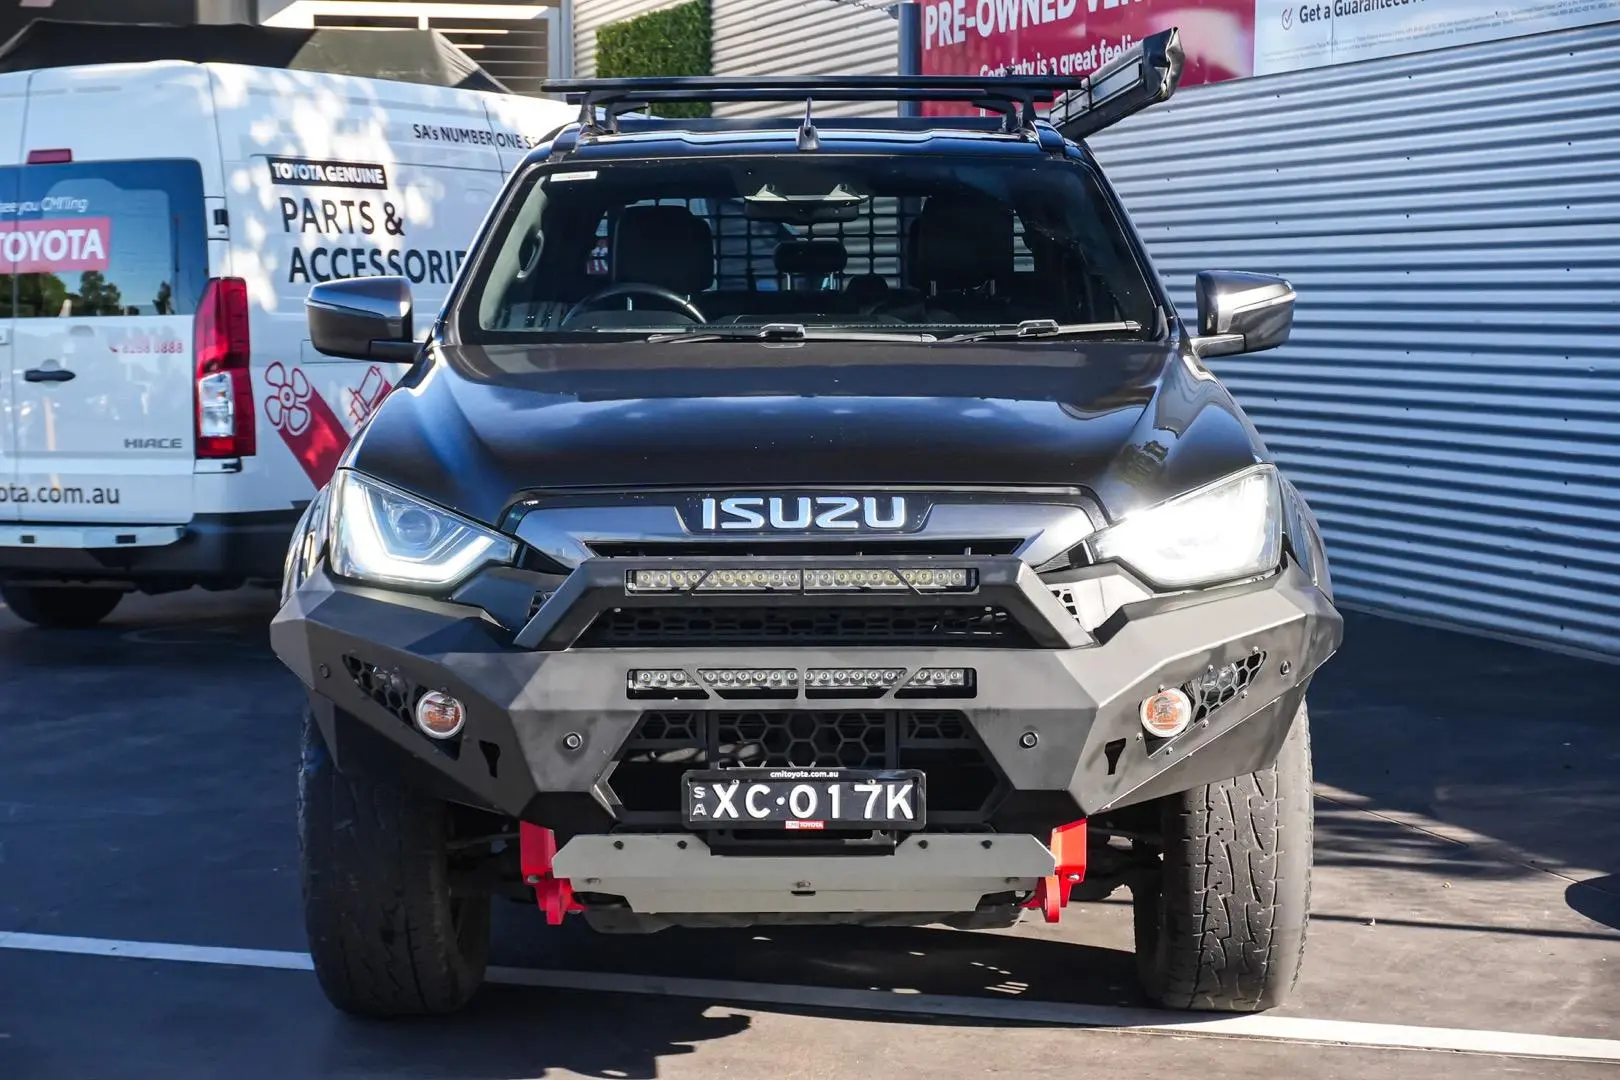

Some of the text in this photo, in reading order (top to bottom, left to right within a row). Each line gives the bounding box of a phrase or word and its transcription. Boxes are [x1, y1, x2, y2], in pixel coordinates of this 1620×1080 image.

[925, 0, 1076, 49] PRE-OWNED
[1300, 4, 1321, 24] Get
[1323, 9, 1331, 19] a
[1037, 51, 1048, 76] is
[1060, 44, 1098, 75] great
[413, 124, 439, 141] SA's
[440, 127, 495, 146] NUMBER
[496, 132, 523, 149] ONE
[272, 162, 385, 184] TOYOTA GENUINE
[280, 197, 406, 236] PARTS &
[123, 437, 183, 449] HIACE
[702, 496, 906, 530] ISUZU
[770, 771, 839, 780] cmitoyota.com.au
